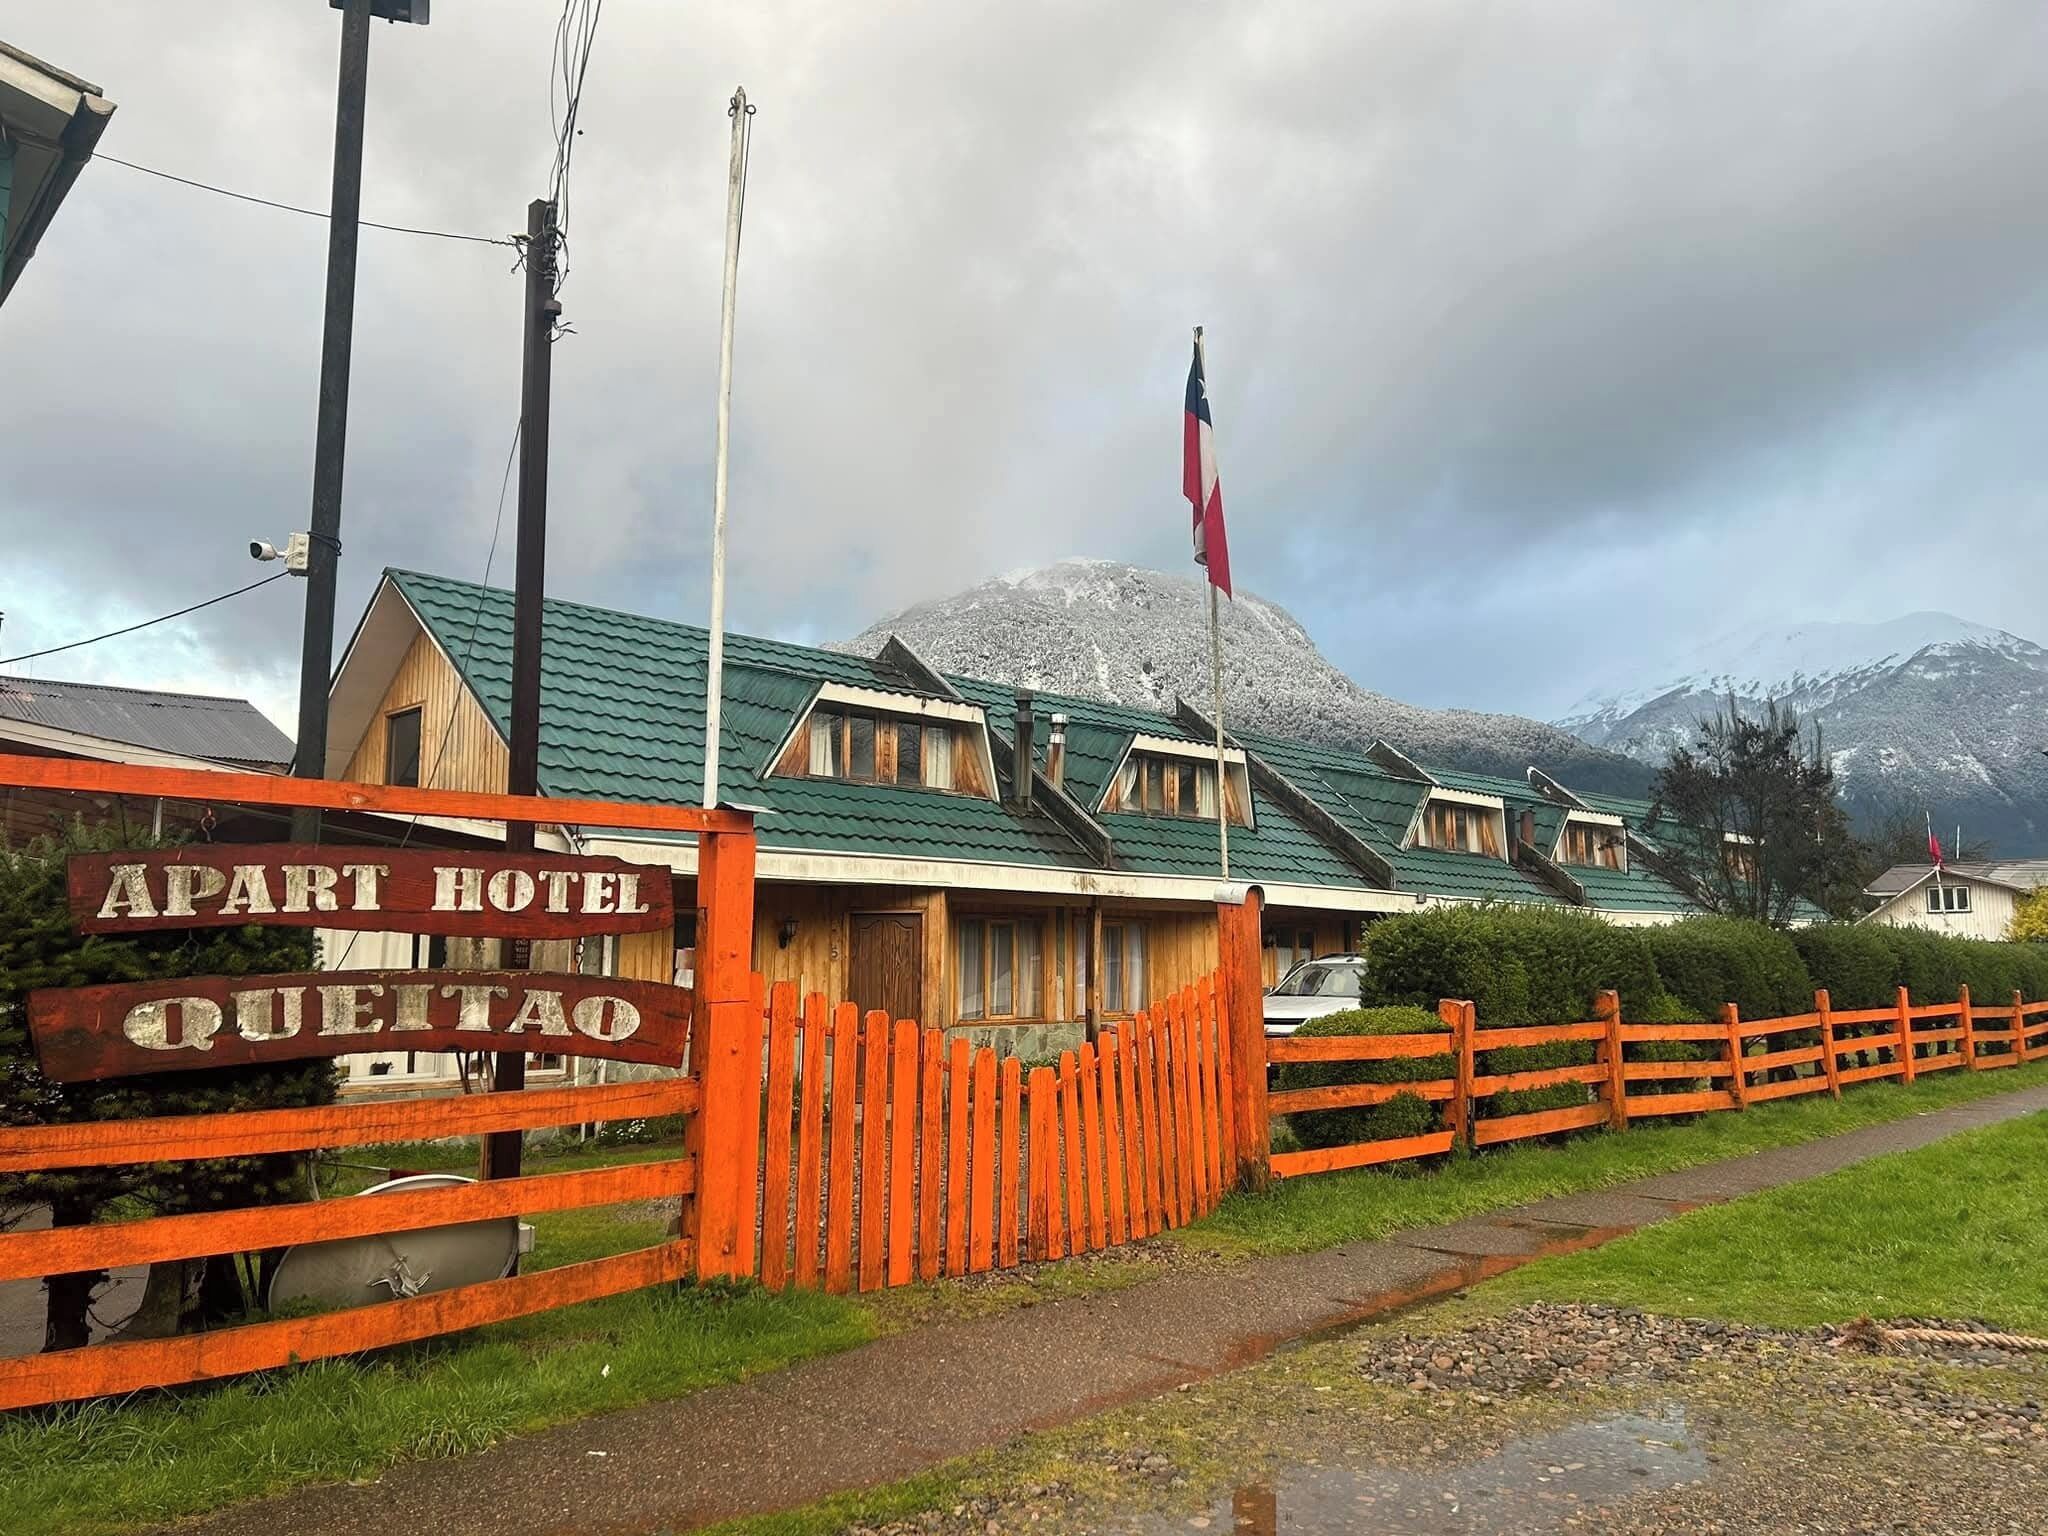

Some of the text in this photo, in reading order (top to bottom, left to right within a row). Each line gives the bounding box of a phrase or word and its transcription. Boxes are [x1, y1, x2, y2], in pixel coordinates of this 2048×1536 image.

[96, 863, 650, 919] APART HOTEL
[122, 984, 641, 1051] QUEITAO
